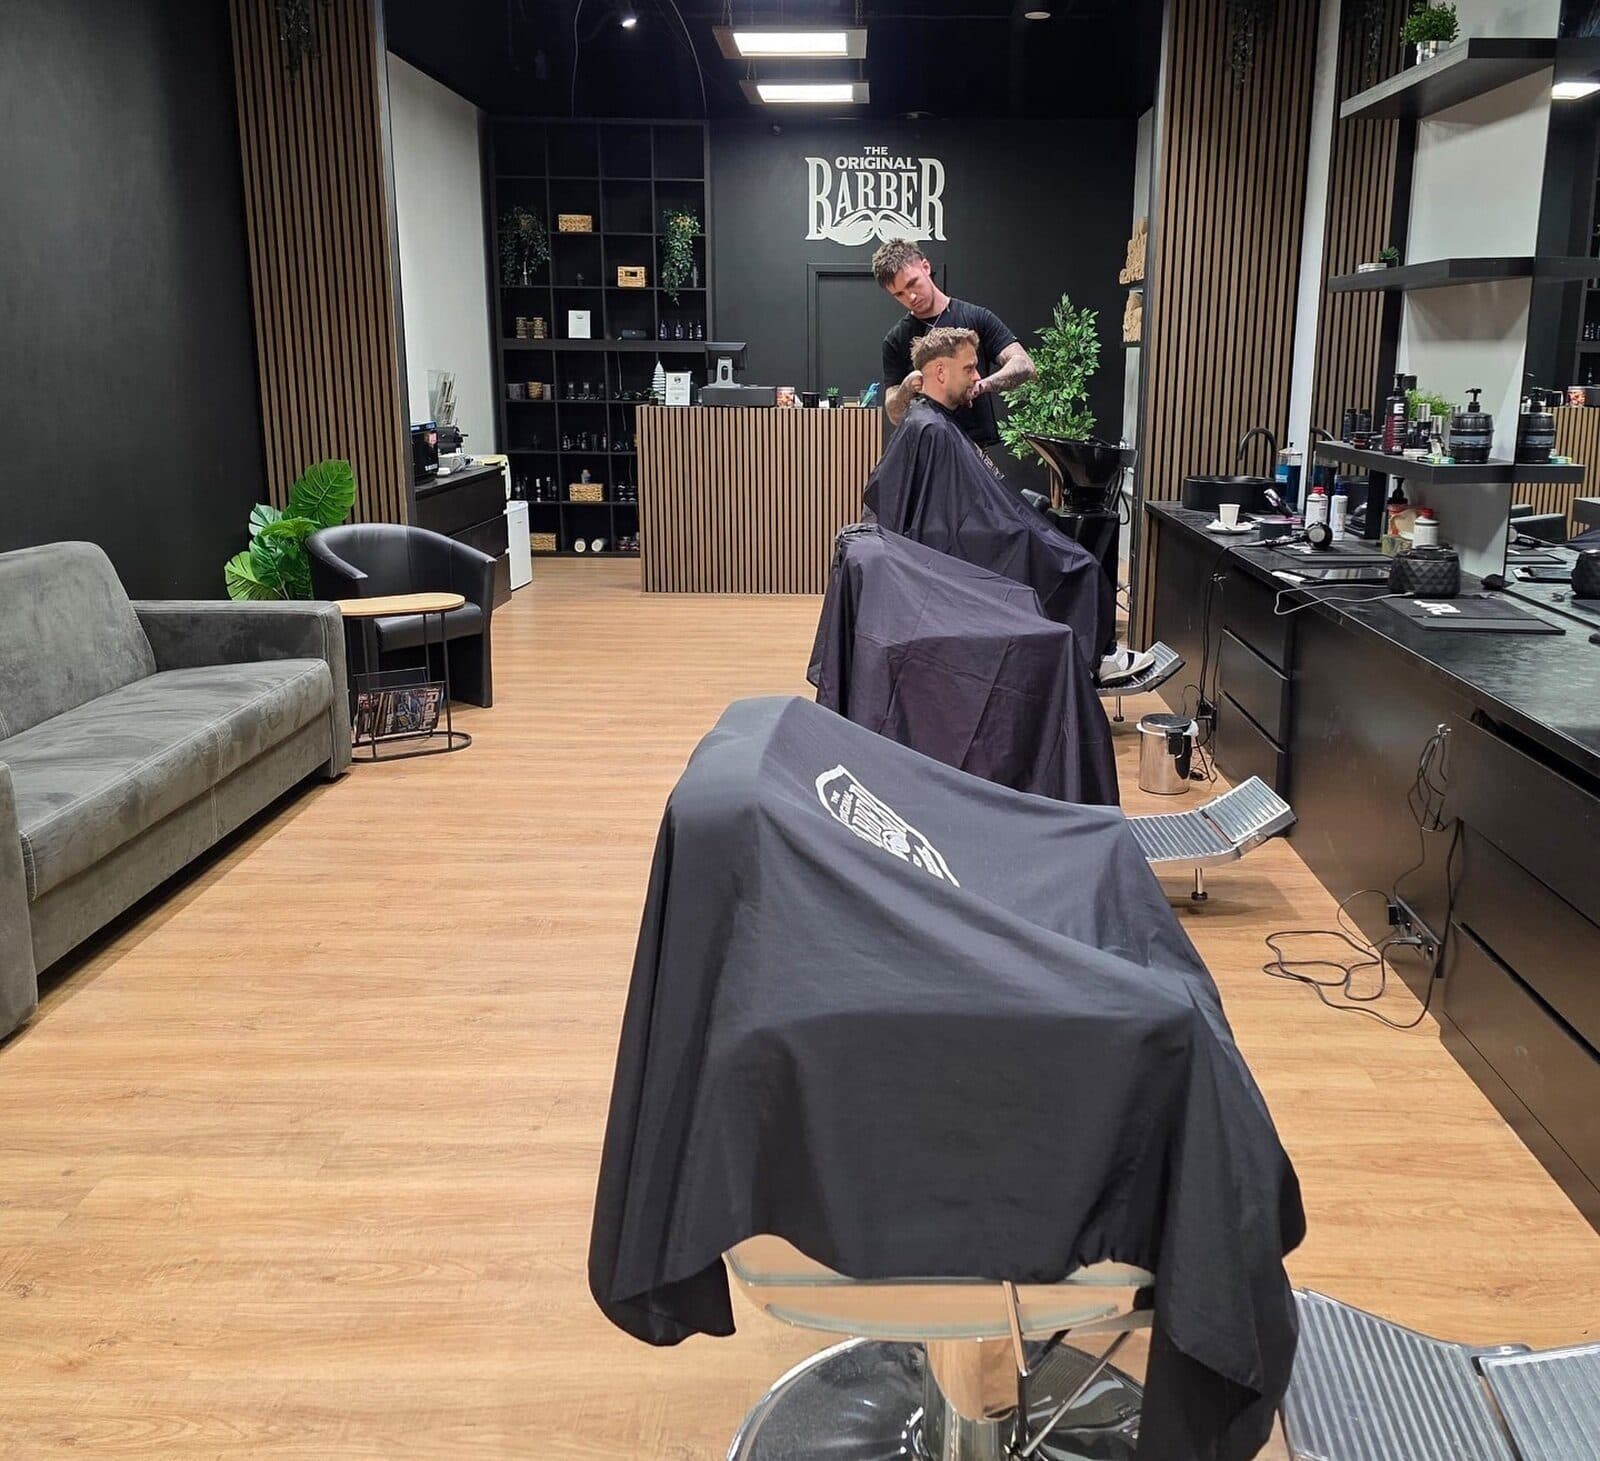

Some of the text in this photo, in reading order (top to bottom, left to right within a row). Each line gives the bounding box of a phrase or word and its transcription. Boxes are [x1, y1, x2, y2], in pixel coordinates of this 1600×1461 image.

[864, 146, 888, 155] THE
[835, 156, 917, 170] ORIGINAL
[805, 157, 947, 241] BARBER
